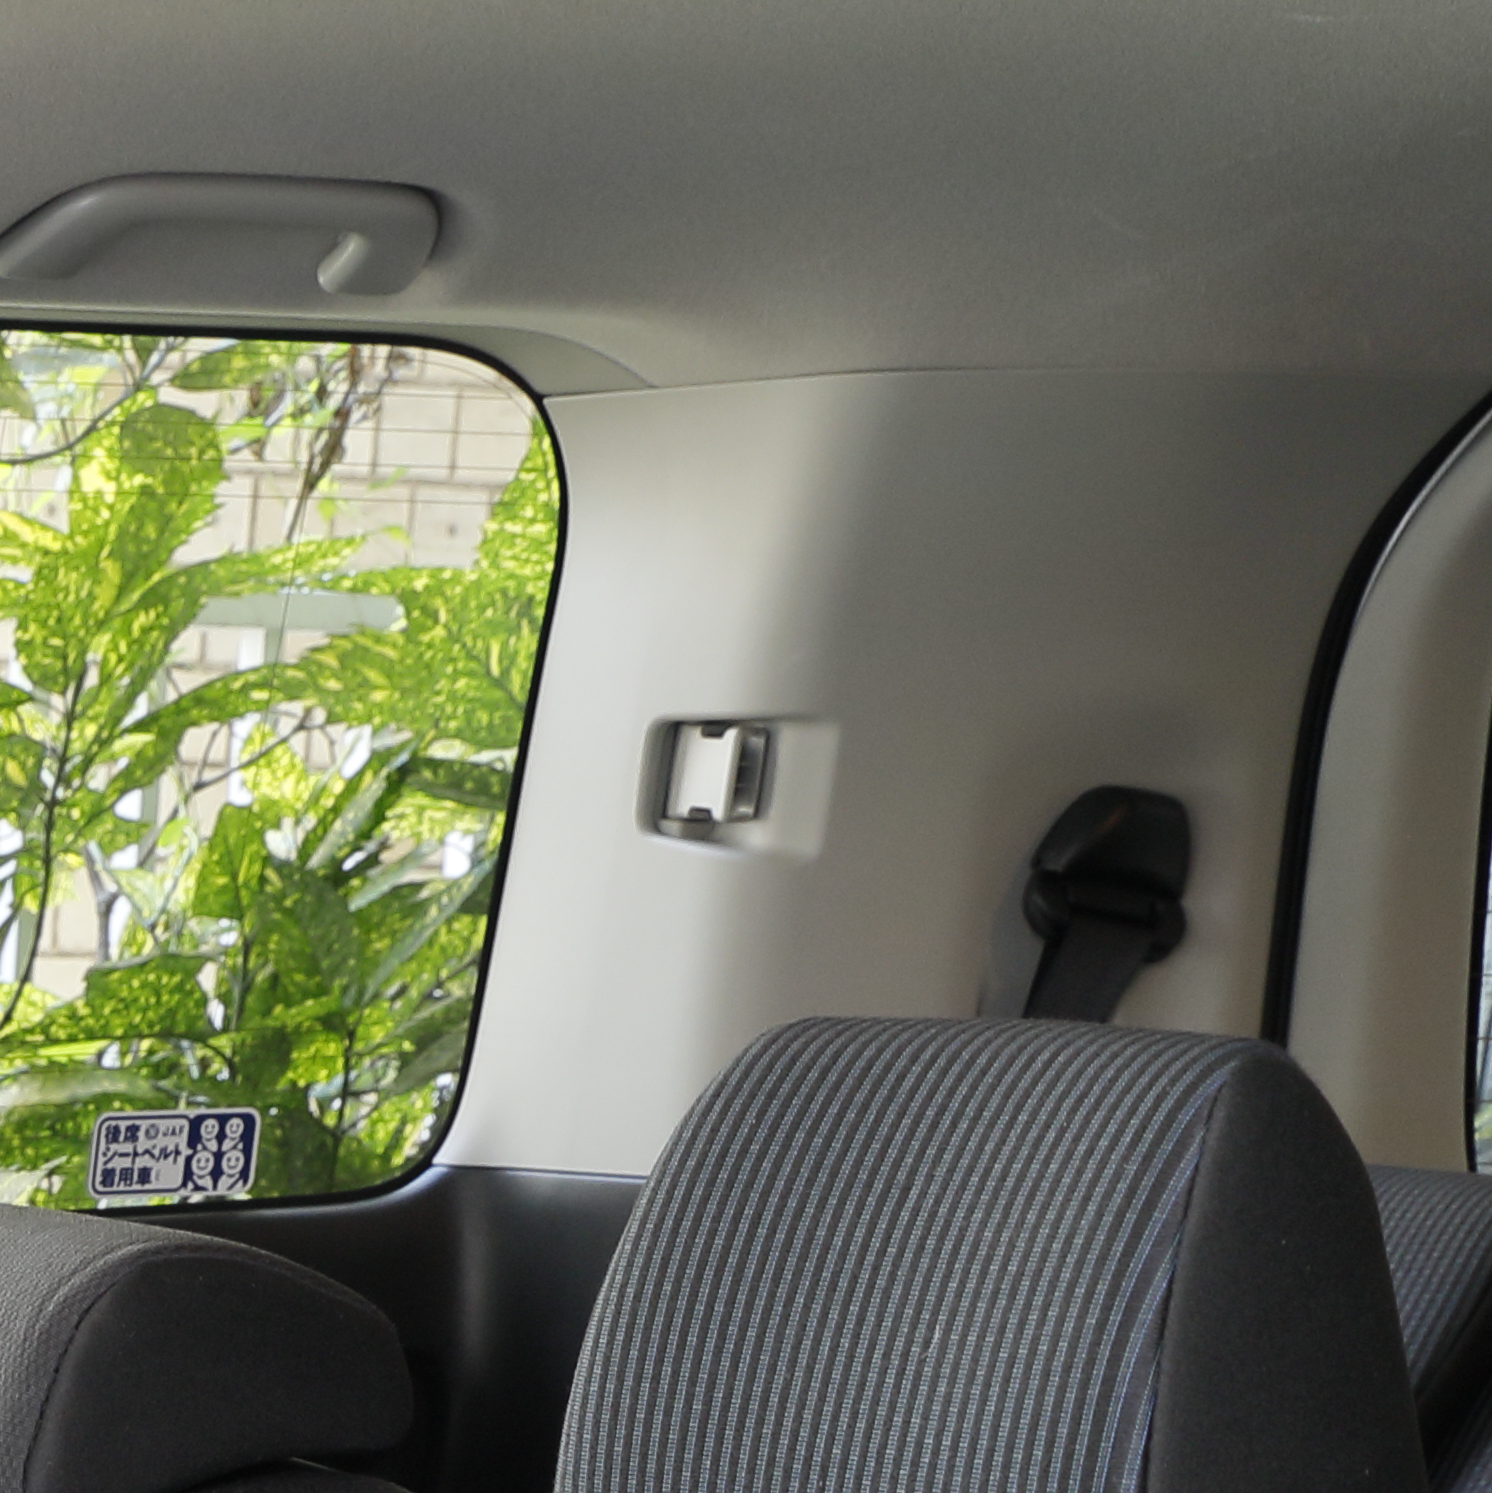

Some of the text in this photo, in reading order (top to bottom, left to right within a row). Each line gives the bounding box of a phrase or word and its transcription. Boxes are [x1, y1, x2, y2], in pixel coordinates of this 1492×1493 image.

[102, 1143, 182, 1166] シートベルト
